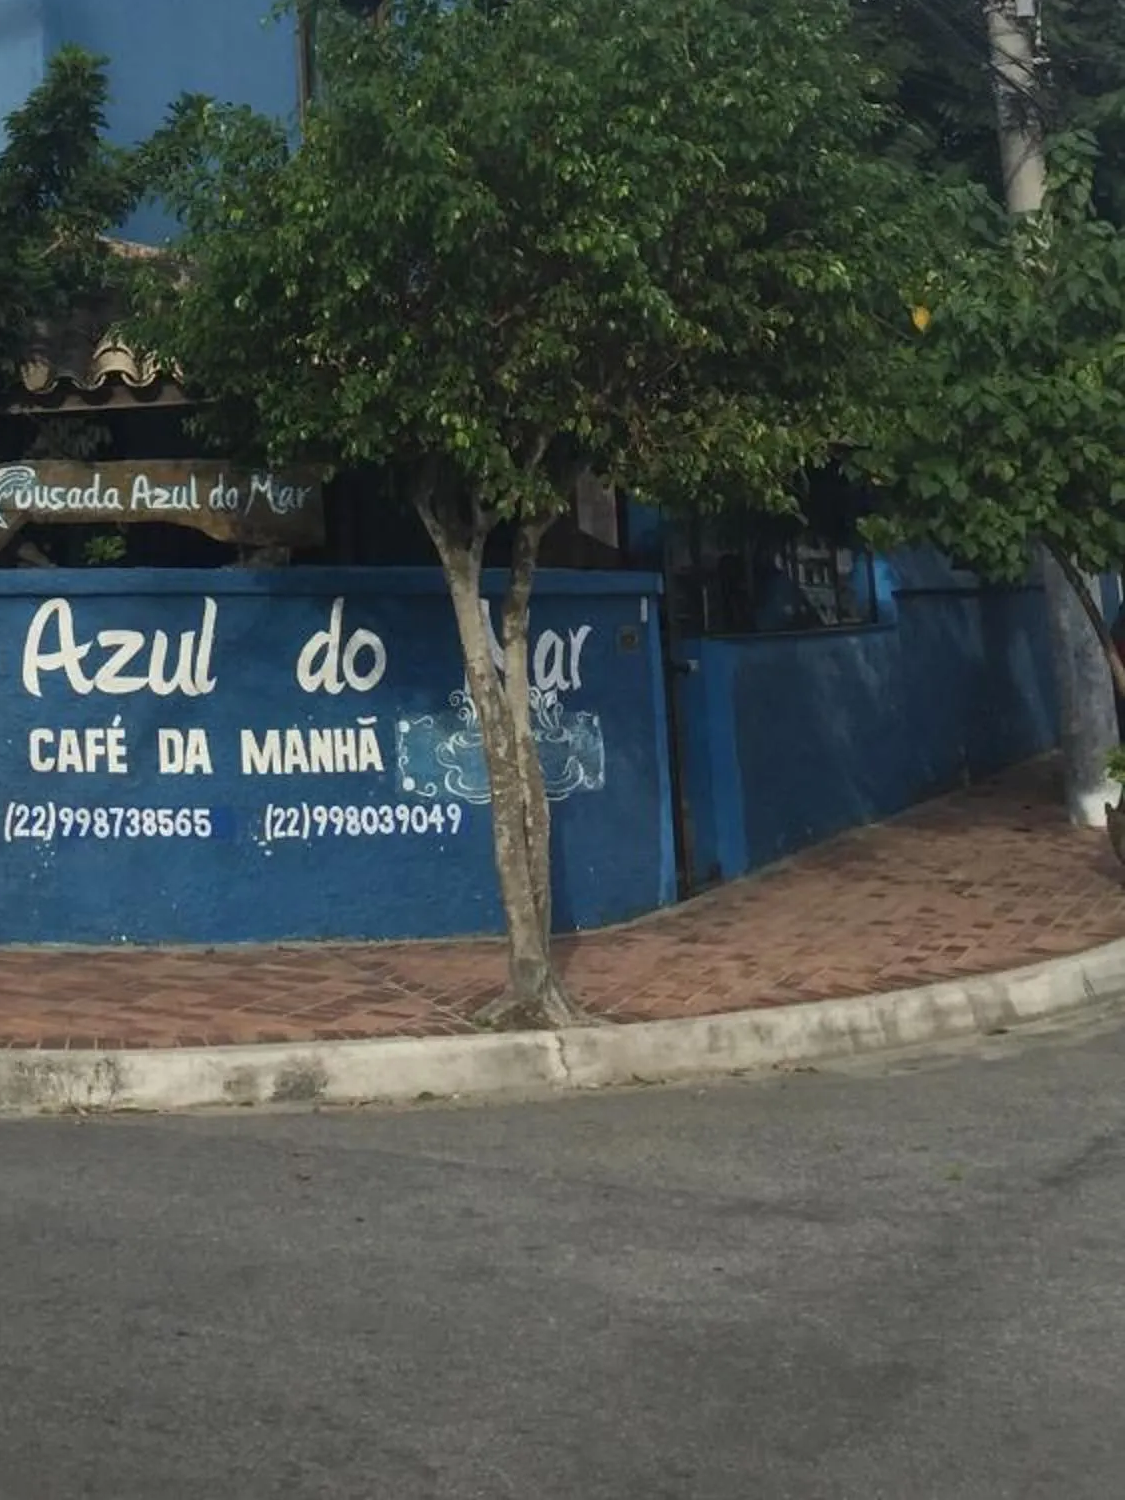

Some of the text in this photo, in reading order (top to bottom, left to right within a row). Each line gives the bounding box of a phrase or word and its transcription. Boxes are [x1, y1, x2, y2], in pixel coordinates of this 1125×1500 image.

[131, 474, 200, 511] Azul
[208, 472, 239, 512] do
[245, 474, 312, 516] Mar
[22, 596, 219, 698] Azul
[296, 596, 387, 695] do
[28, 714, 129, 774] CAFÉ
[158, 727, 213, 775] DA
[239, 715, 384, 776] MANHÃ
[3, 801, 212, 841] (22)998738565
[264, 802, 462, 840] (22)998039049
